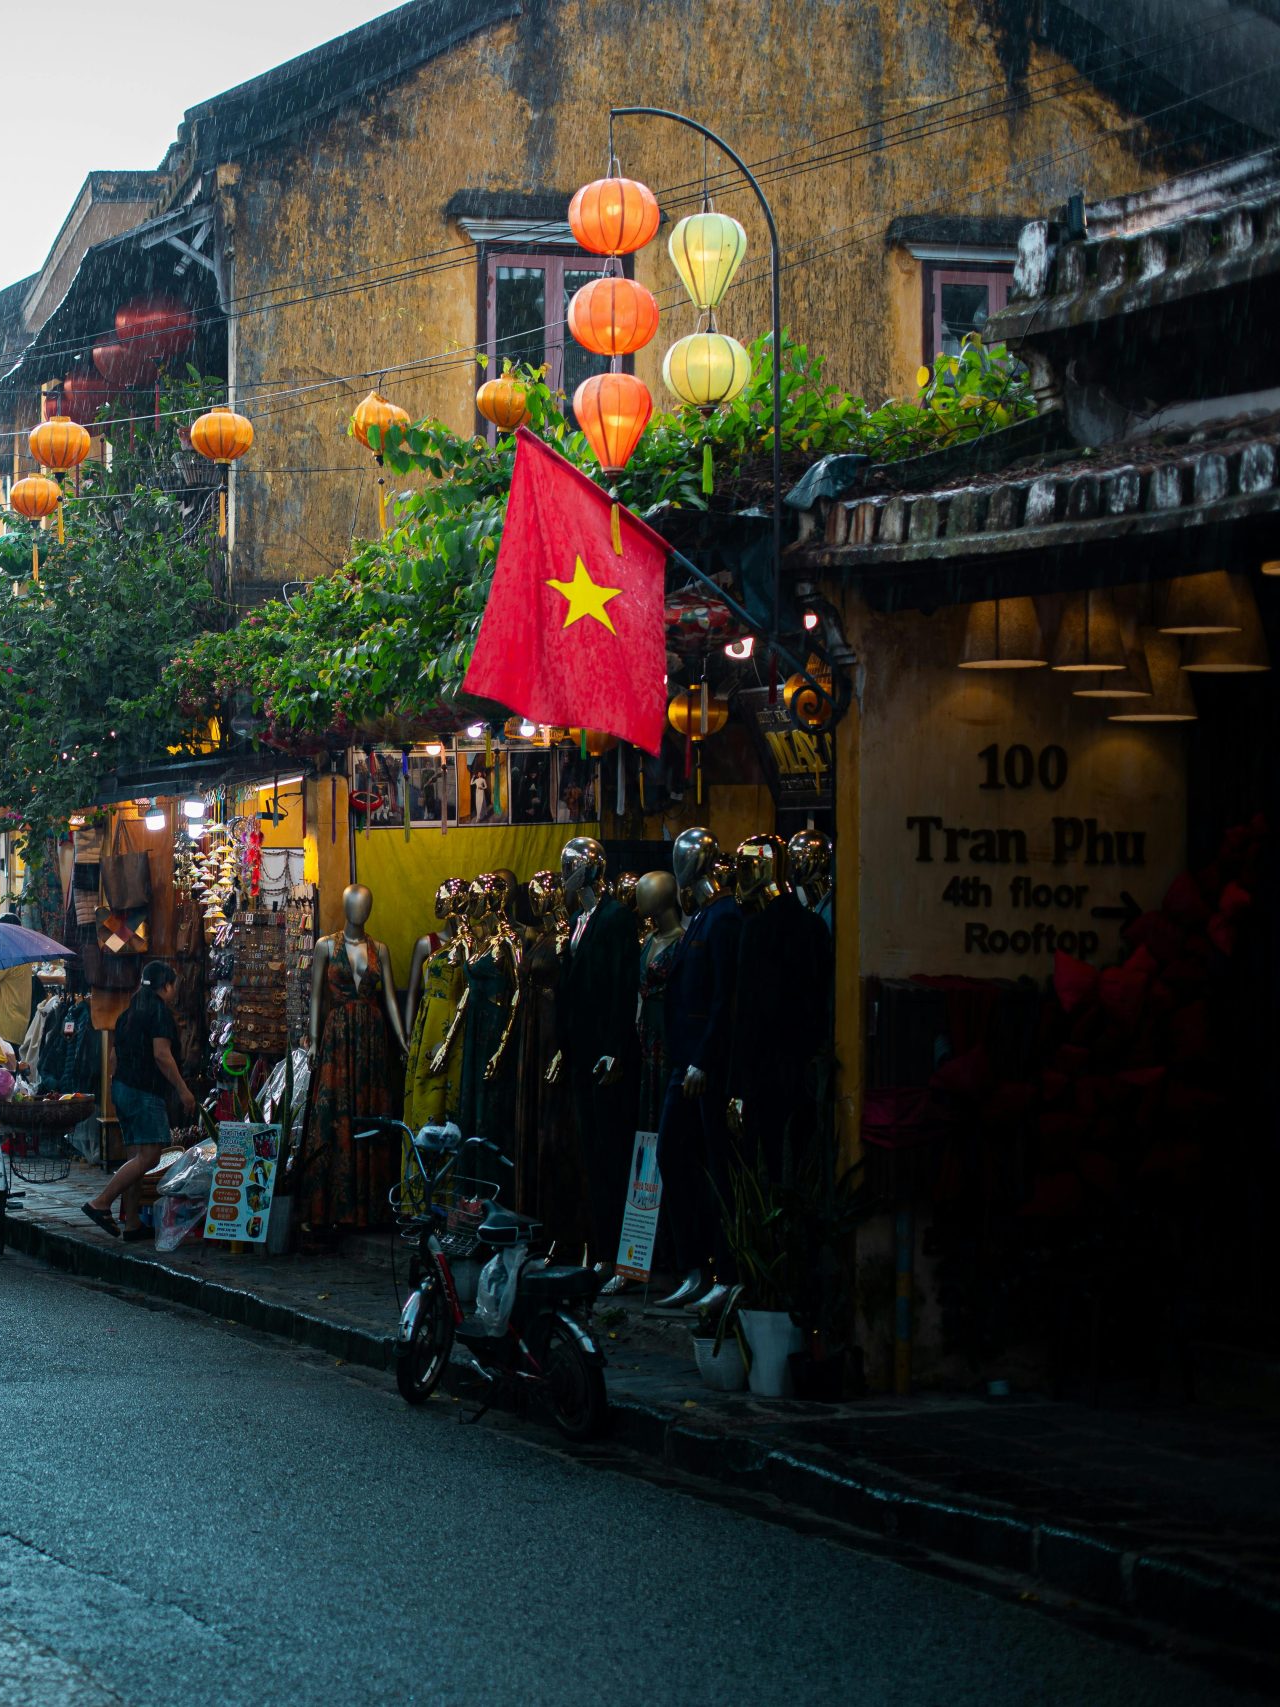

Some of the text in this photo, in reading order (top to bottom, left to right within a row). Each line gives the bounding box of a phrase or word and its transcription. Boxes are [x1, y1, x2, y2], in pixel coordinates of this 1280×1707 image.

[977, 743, 1068, 790] 100
[906, 816, 1147, 866] Tran Phu
[942, 875, 1089, 909] 4th floor
[964, 922, 1100, 961] Rooftop
